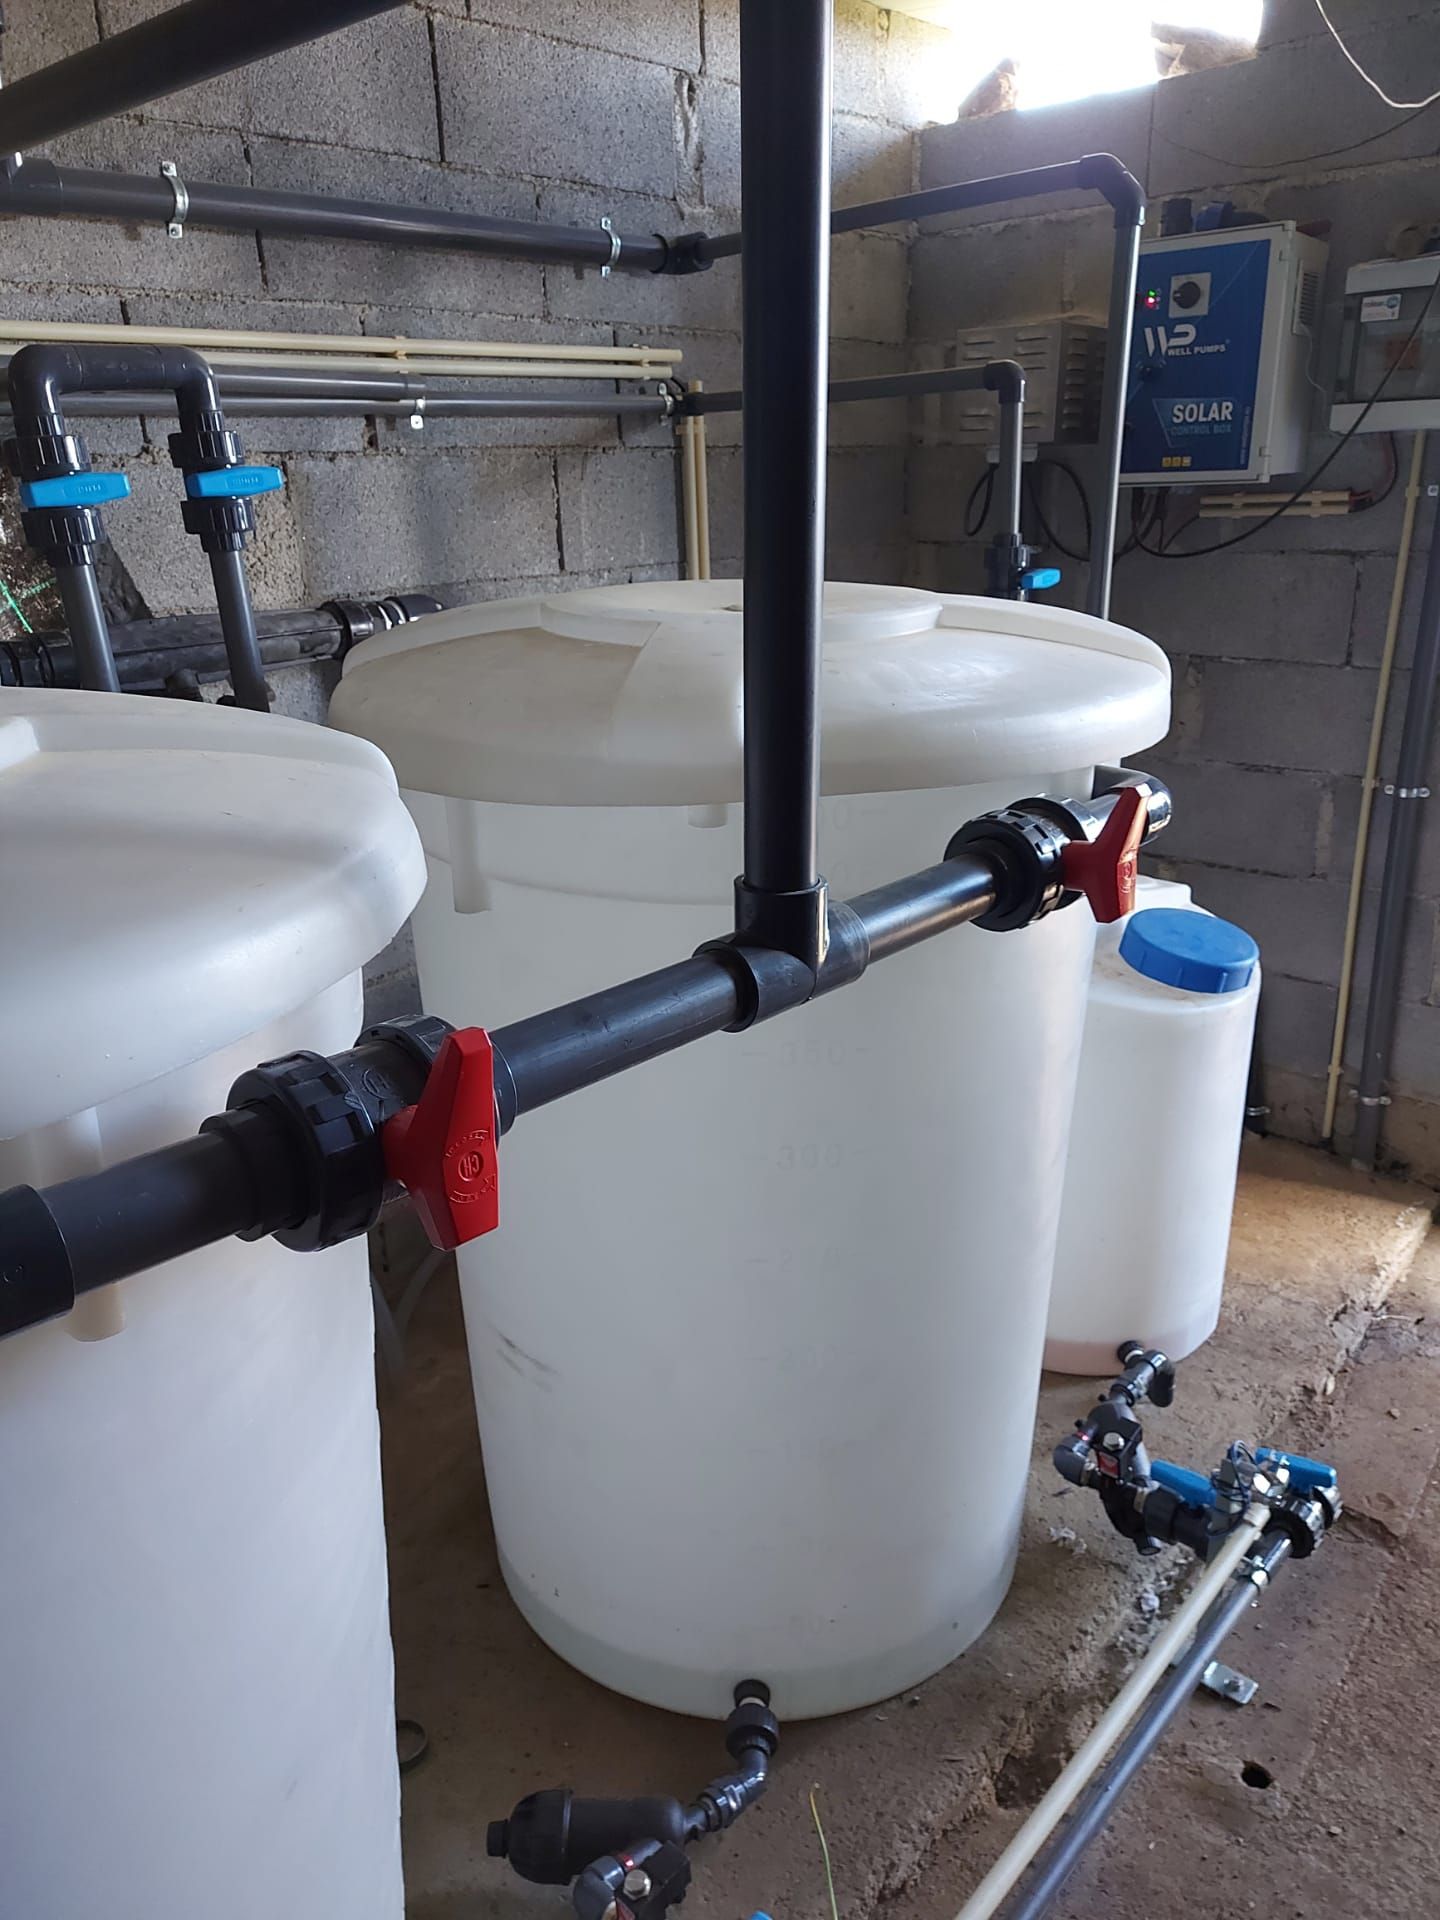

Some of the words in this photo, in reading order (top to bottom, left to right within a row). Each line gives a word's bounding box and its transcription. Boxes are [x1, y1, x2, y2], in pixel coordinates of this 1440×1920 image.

[1168, 346, 1192, 356] WELL
[1193, 344, 1226, 354] PUMPS
[1172, 401, 1233, 423] SOLAR
